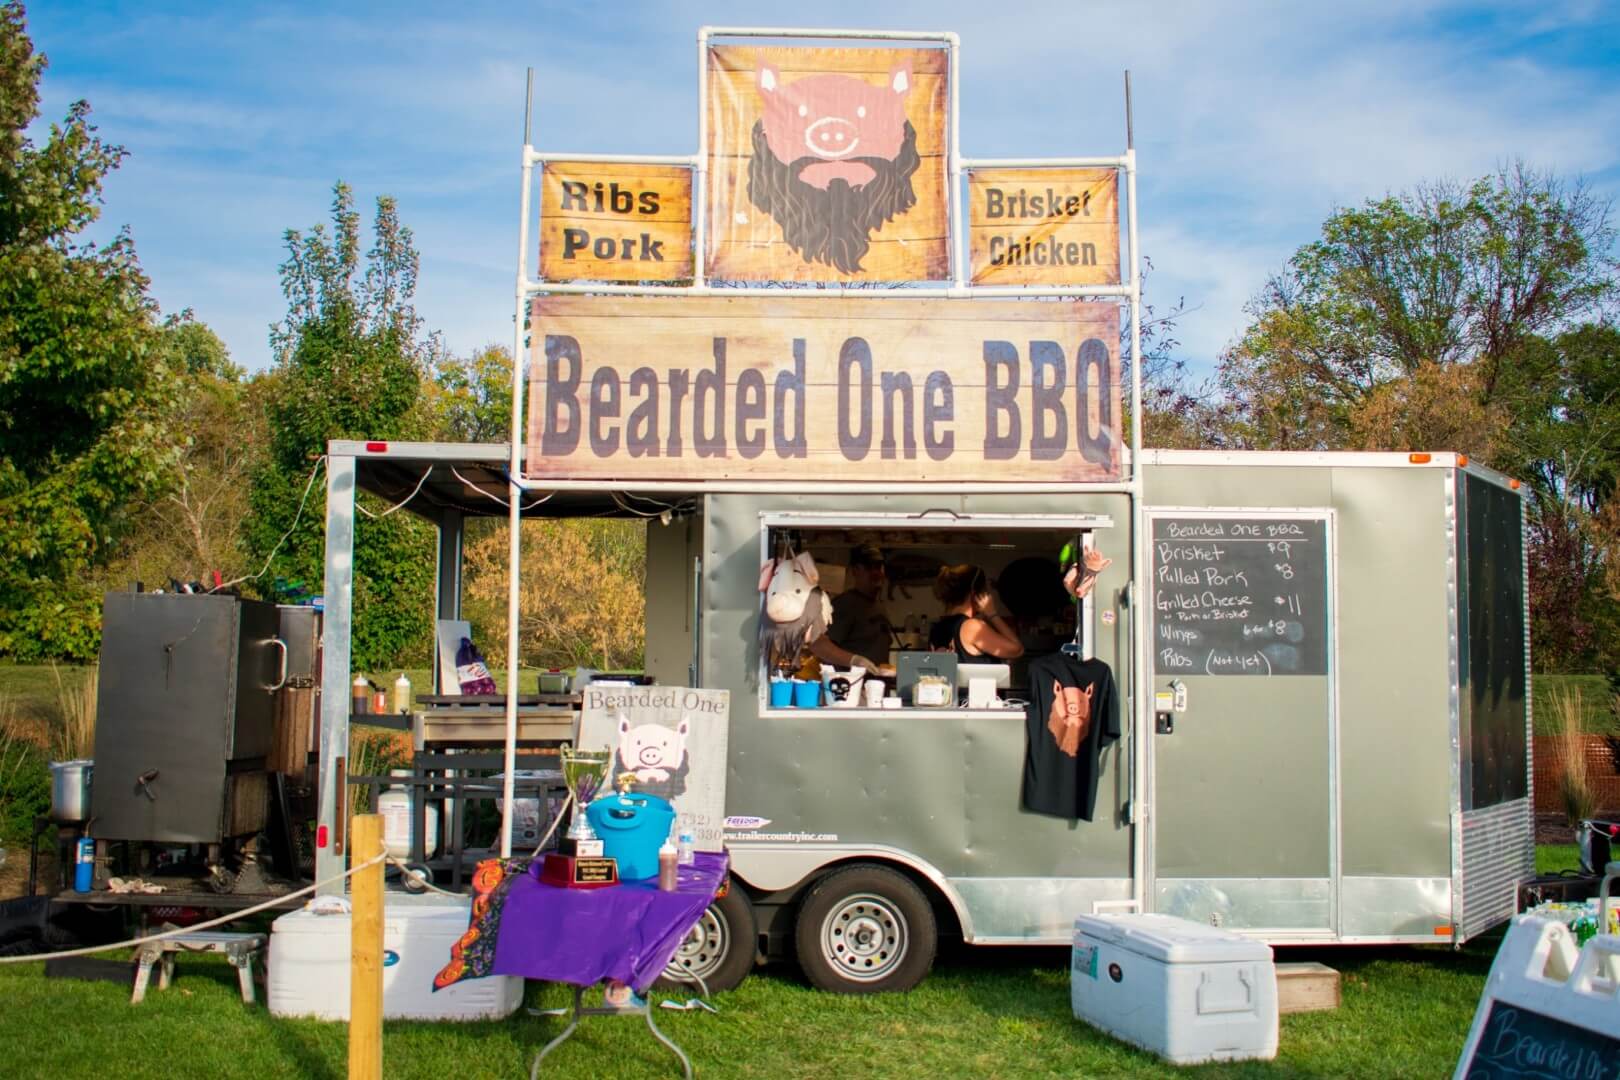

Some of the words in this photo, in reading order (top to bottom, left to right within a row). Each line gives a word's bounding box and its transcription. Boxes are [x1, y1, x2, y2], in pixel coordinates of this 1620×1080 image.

[561, 181, 660, 215] Ribs
[985, 187, 1092, 219] Brisket
[562, 228, 665, 262] Pork
[988, 235, 1098, 267] Chicken
[542, 334, 808, 459] Bearded
[838, 336, 955, 462] One
[982, 338, 1113, 474] BBQ
[1167, 522, 1225, 538] Bearded
[1266, 524, 1304, 537] BBQ
[1158, 542, 1225, 564] Brisket
[1158, 565, 1200, 585] Pulled
[1202, 567, 1249, 587] Pork
[1157, 589, 1200, 611] Grilled
[1201, 591, 1253, 608] Cheese
[1160, 624, 1198, 645] Wings
[1160, 648, 1192, 667] Ribs
[590, 690, 676, 710] Bearded
[682, 692, 725, 714] One
[1494, 1009, 1582, 1079] Bearded
